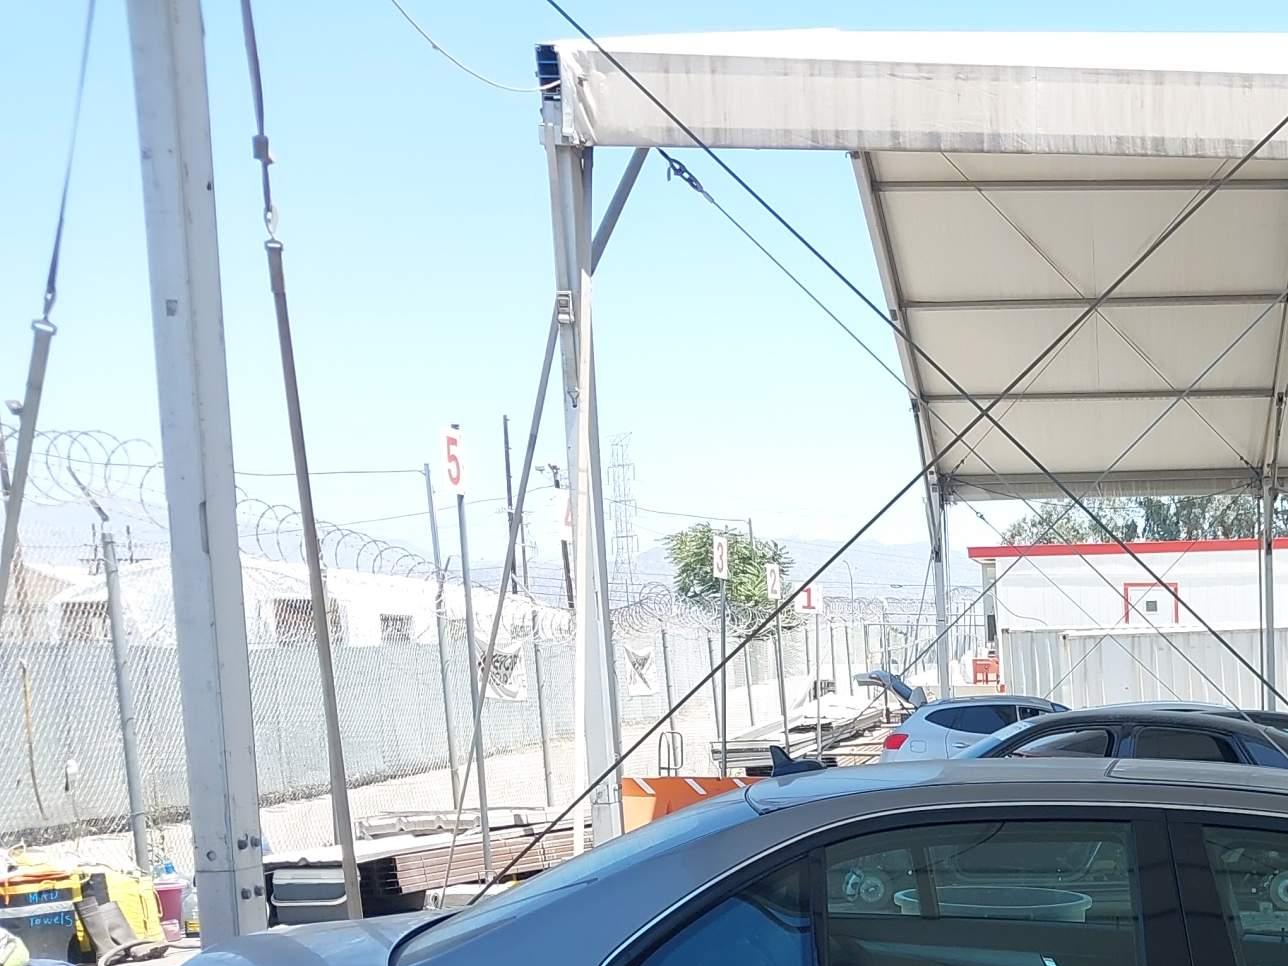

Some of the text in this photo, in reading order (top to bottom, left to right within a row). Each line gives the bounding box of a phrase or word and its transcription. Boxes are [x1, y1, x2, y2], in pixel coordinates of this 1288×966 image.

[446, 436, 461, 486] 5
[717, 542, 724, 573] 3
[769, 568, 778, 595] 2
[802, 587, 816, 609] 1
